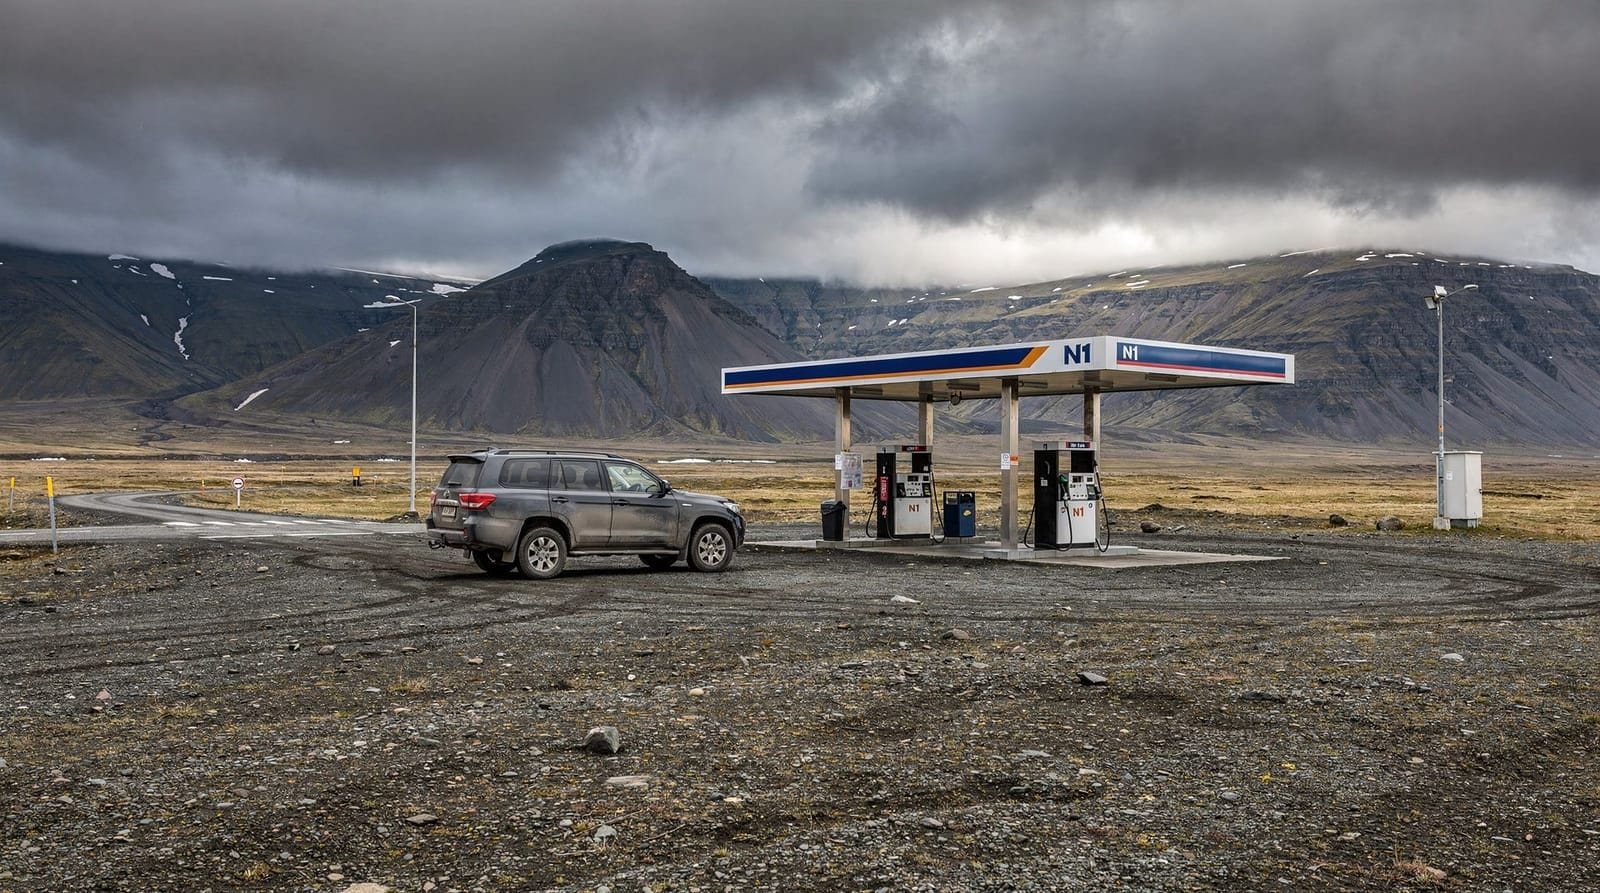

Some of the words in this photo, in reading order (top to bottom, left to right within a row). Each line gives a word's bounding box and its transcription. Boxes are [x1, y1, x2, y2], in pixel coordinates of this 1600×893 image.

[1064, 343, 1091, 364] N1
[1123, 346, 1138, 360] N1
[908, 504, 920, 513] N1
[1073, 508, 1084, 517] N1
